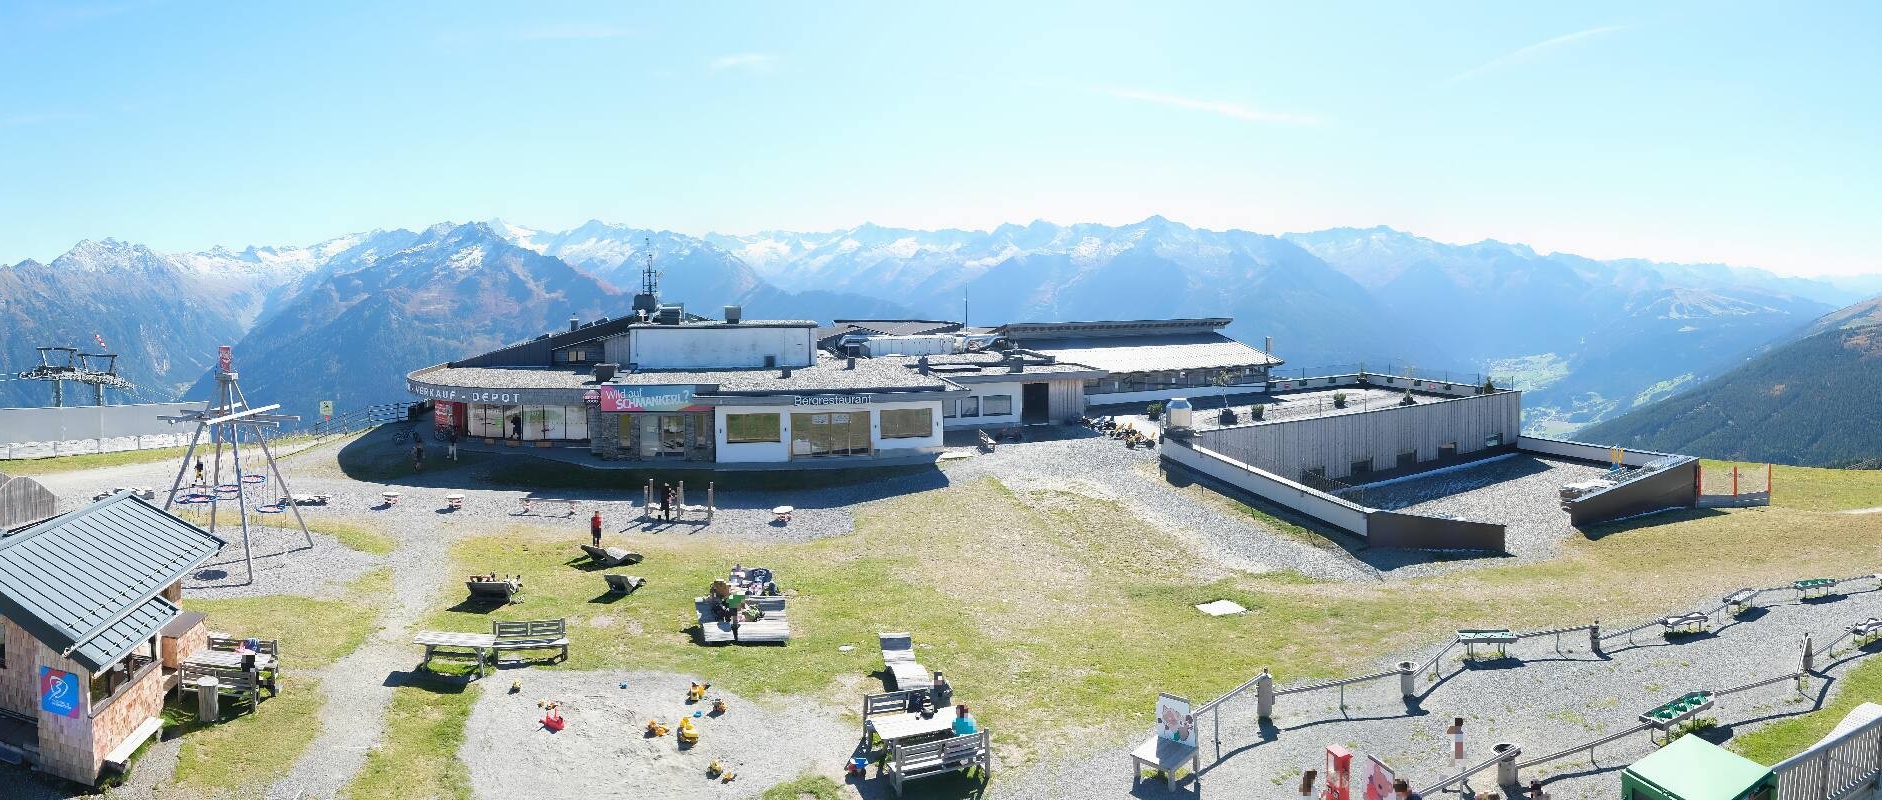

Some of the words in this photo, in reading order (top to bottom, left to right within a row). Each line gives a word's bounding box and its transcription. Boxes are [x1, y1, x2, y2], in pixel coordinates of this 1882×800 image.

[415, 386, 456, 400] VERKAUF
[472, 392, 520, 403] DEPOT
[605, 389, 626, 399] Wild
[628, 387, 643, 399] auf
[615, 389, 690, 410] SCHMANKERL?
[795, 394, 872, 406] Bergrestaurant
